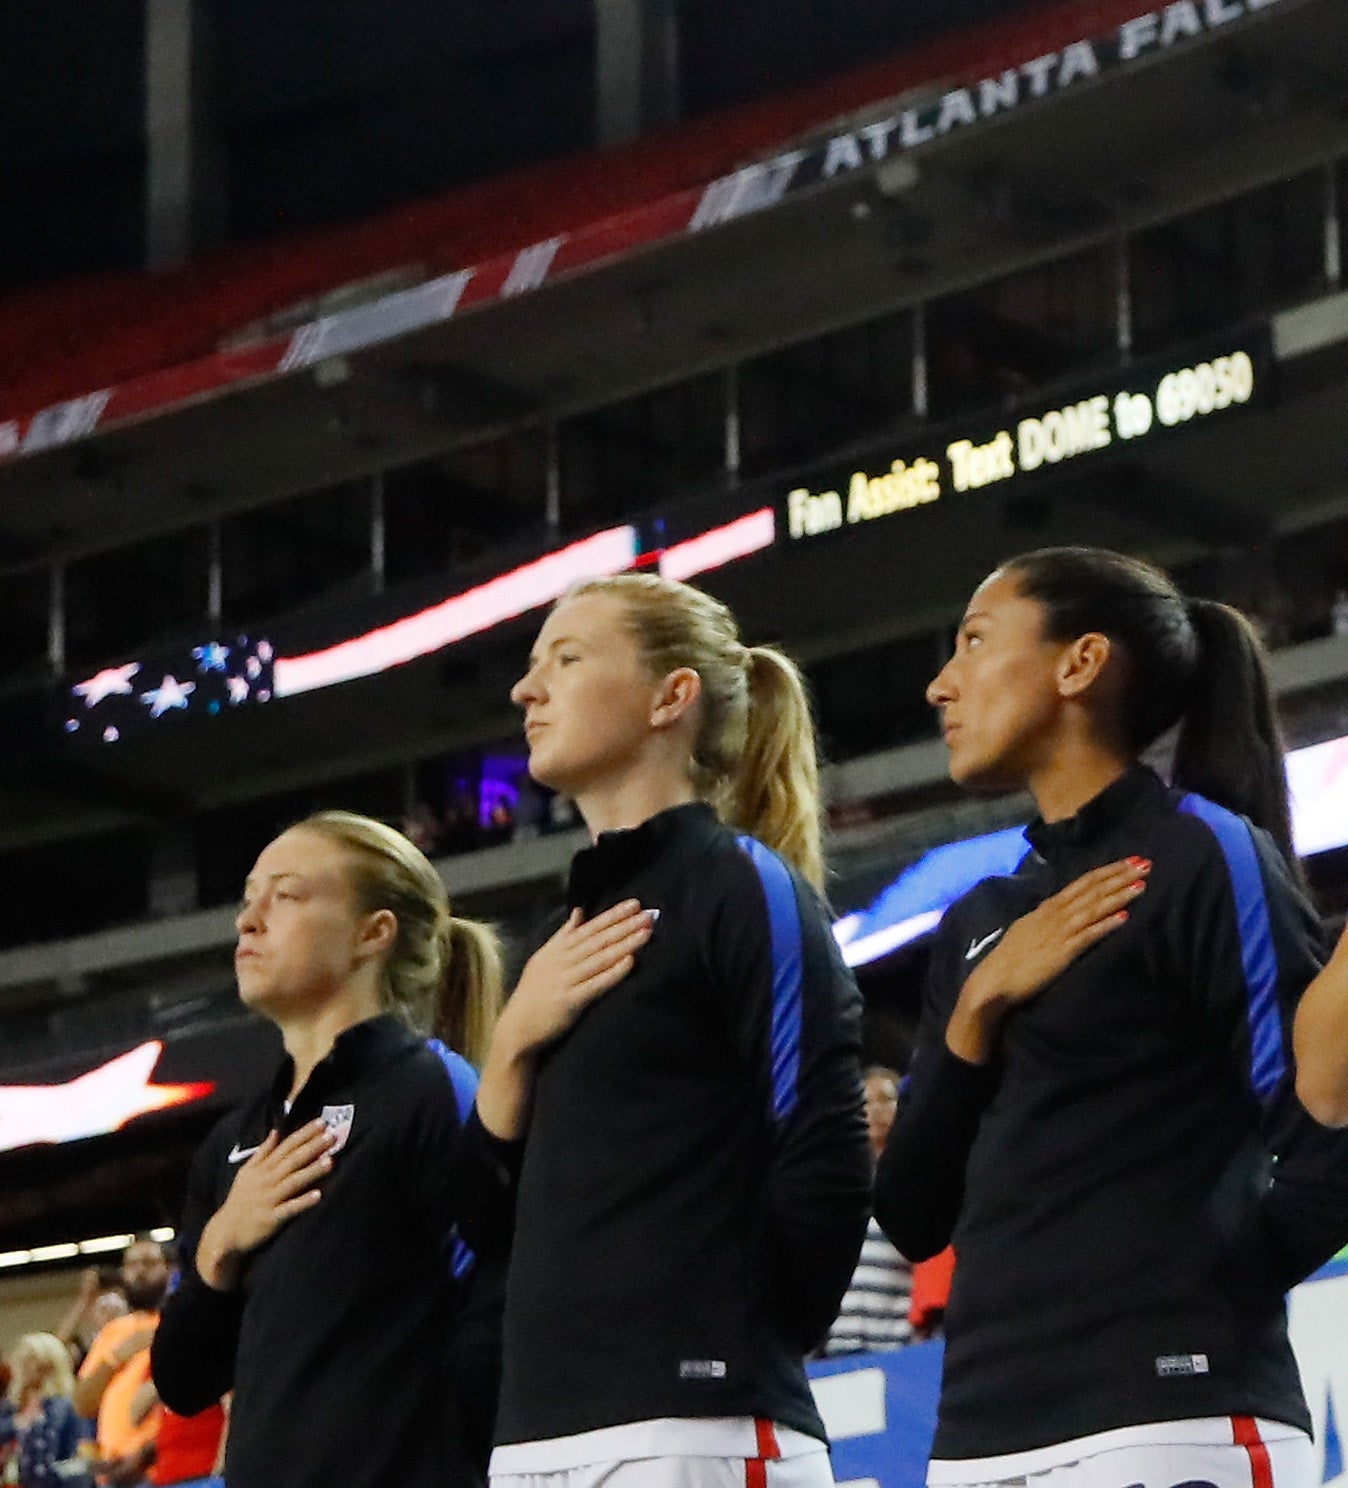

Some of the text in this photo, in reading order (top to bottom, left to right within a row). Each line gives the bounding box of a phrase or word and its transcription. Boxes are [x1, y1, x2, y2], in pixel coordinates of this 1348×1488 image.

[822, 0, 1281, 176] ATLANTA FAL
[788, 487, 843, 540] Fan
[946, 430, 1015, 492] Text
[1017, 394, 1112, 471] DOME
[1113, 391, 1153, 440] to
